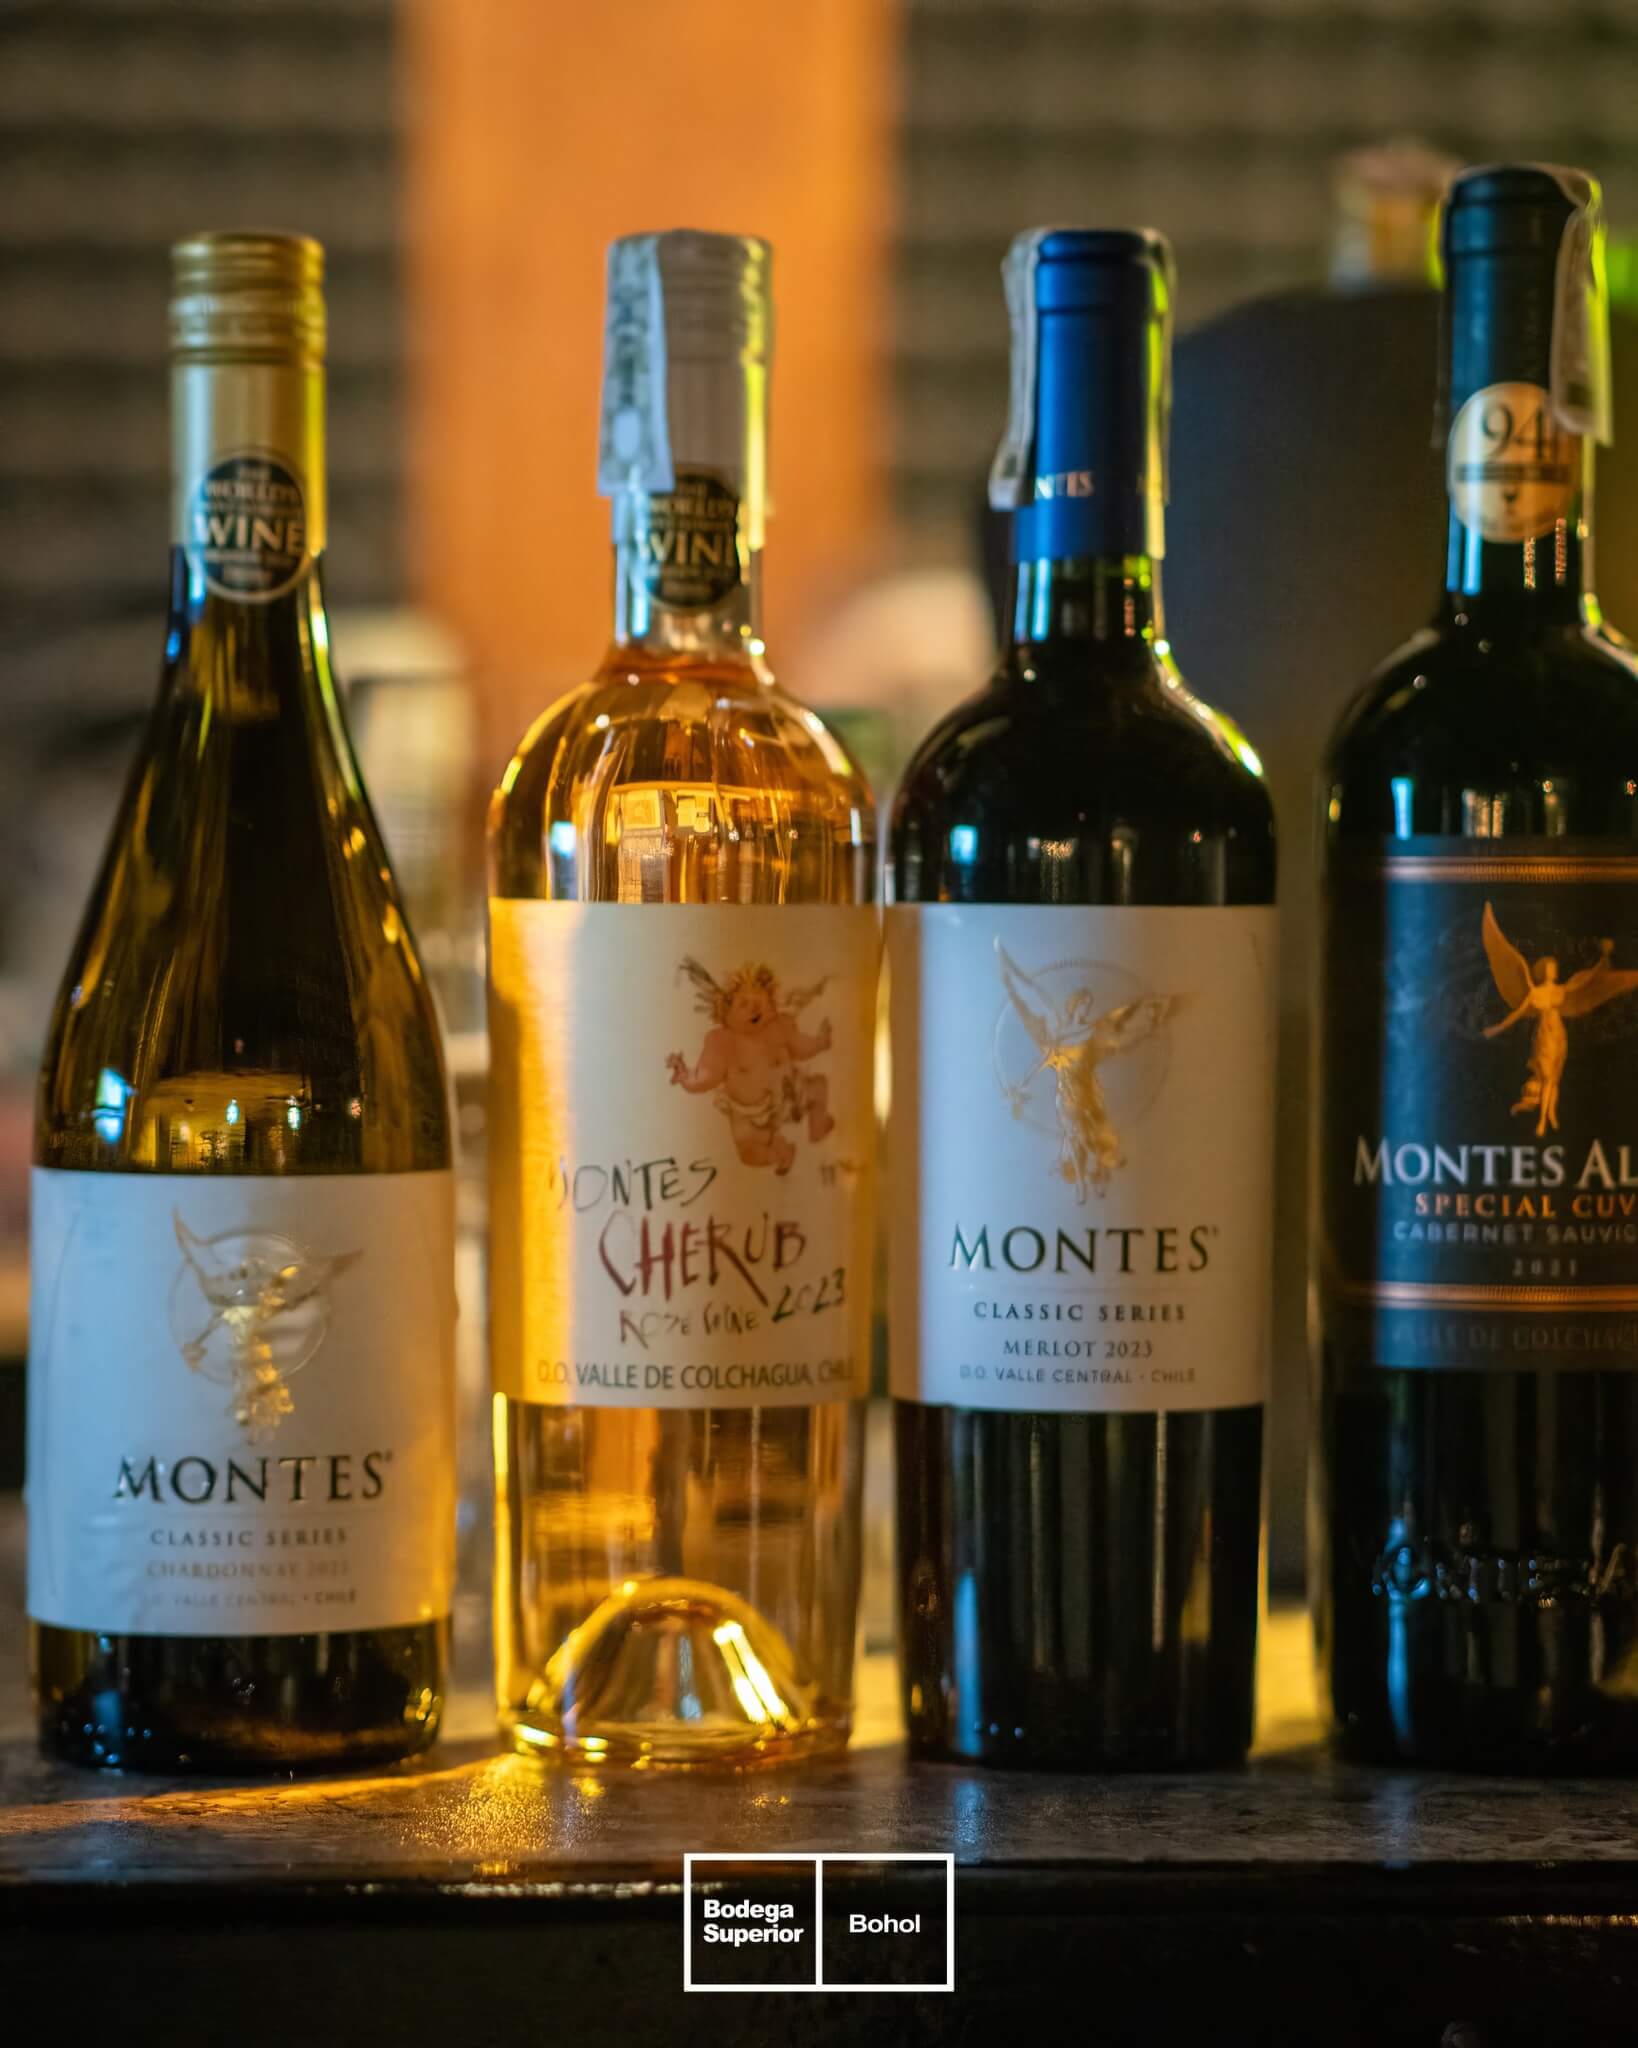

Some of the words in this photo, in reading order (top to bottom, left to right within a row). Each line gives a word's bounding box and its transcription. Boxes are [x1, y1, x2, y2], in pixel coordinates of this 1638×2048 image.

[1352, 1134, 1565, 1188] MONTES
[1415, 1192, 1556, 1218] SPECIAL
[1393, 1220, 1533, 1245] CABERNET
[598, 1210, 806, 1308] CHERUB
[973, 1302, 1084, 1321] CLASSIC
[1097, 1304, 1186, 1322] SERIES
[1002, 1339, 1097, 1358] MERLOT
[1105, 1341, 1154, 1359] 2023
[575, 1361, 639, 1390] VALLE
[643, 1364, 676, 1390] DE
[680, 1362, 811, 1391] COLCHAGUA
[994, 1367, 1045, 1382] VALLE
[1052, 1368, 1134, 1384] CENTRAL
[150, 1530, 254, 1547] CLASSIC
[265, 1528, 347, 1547] SERIES
